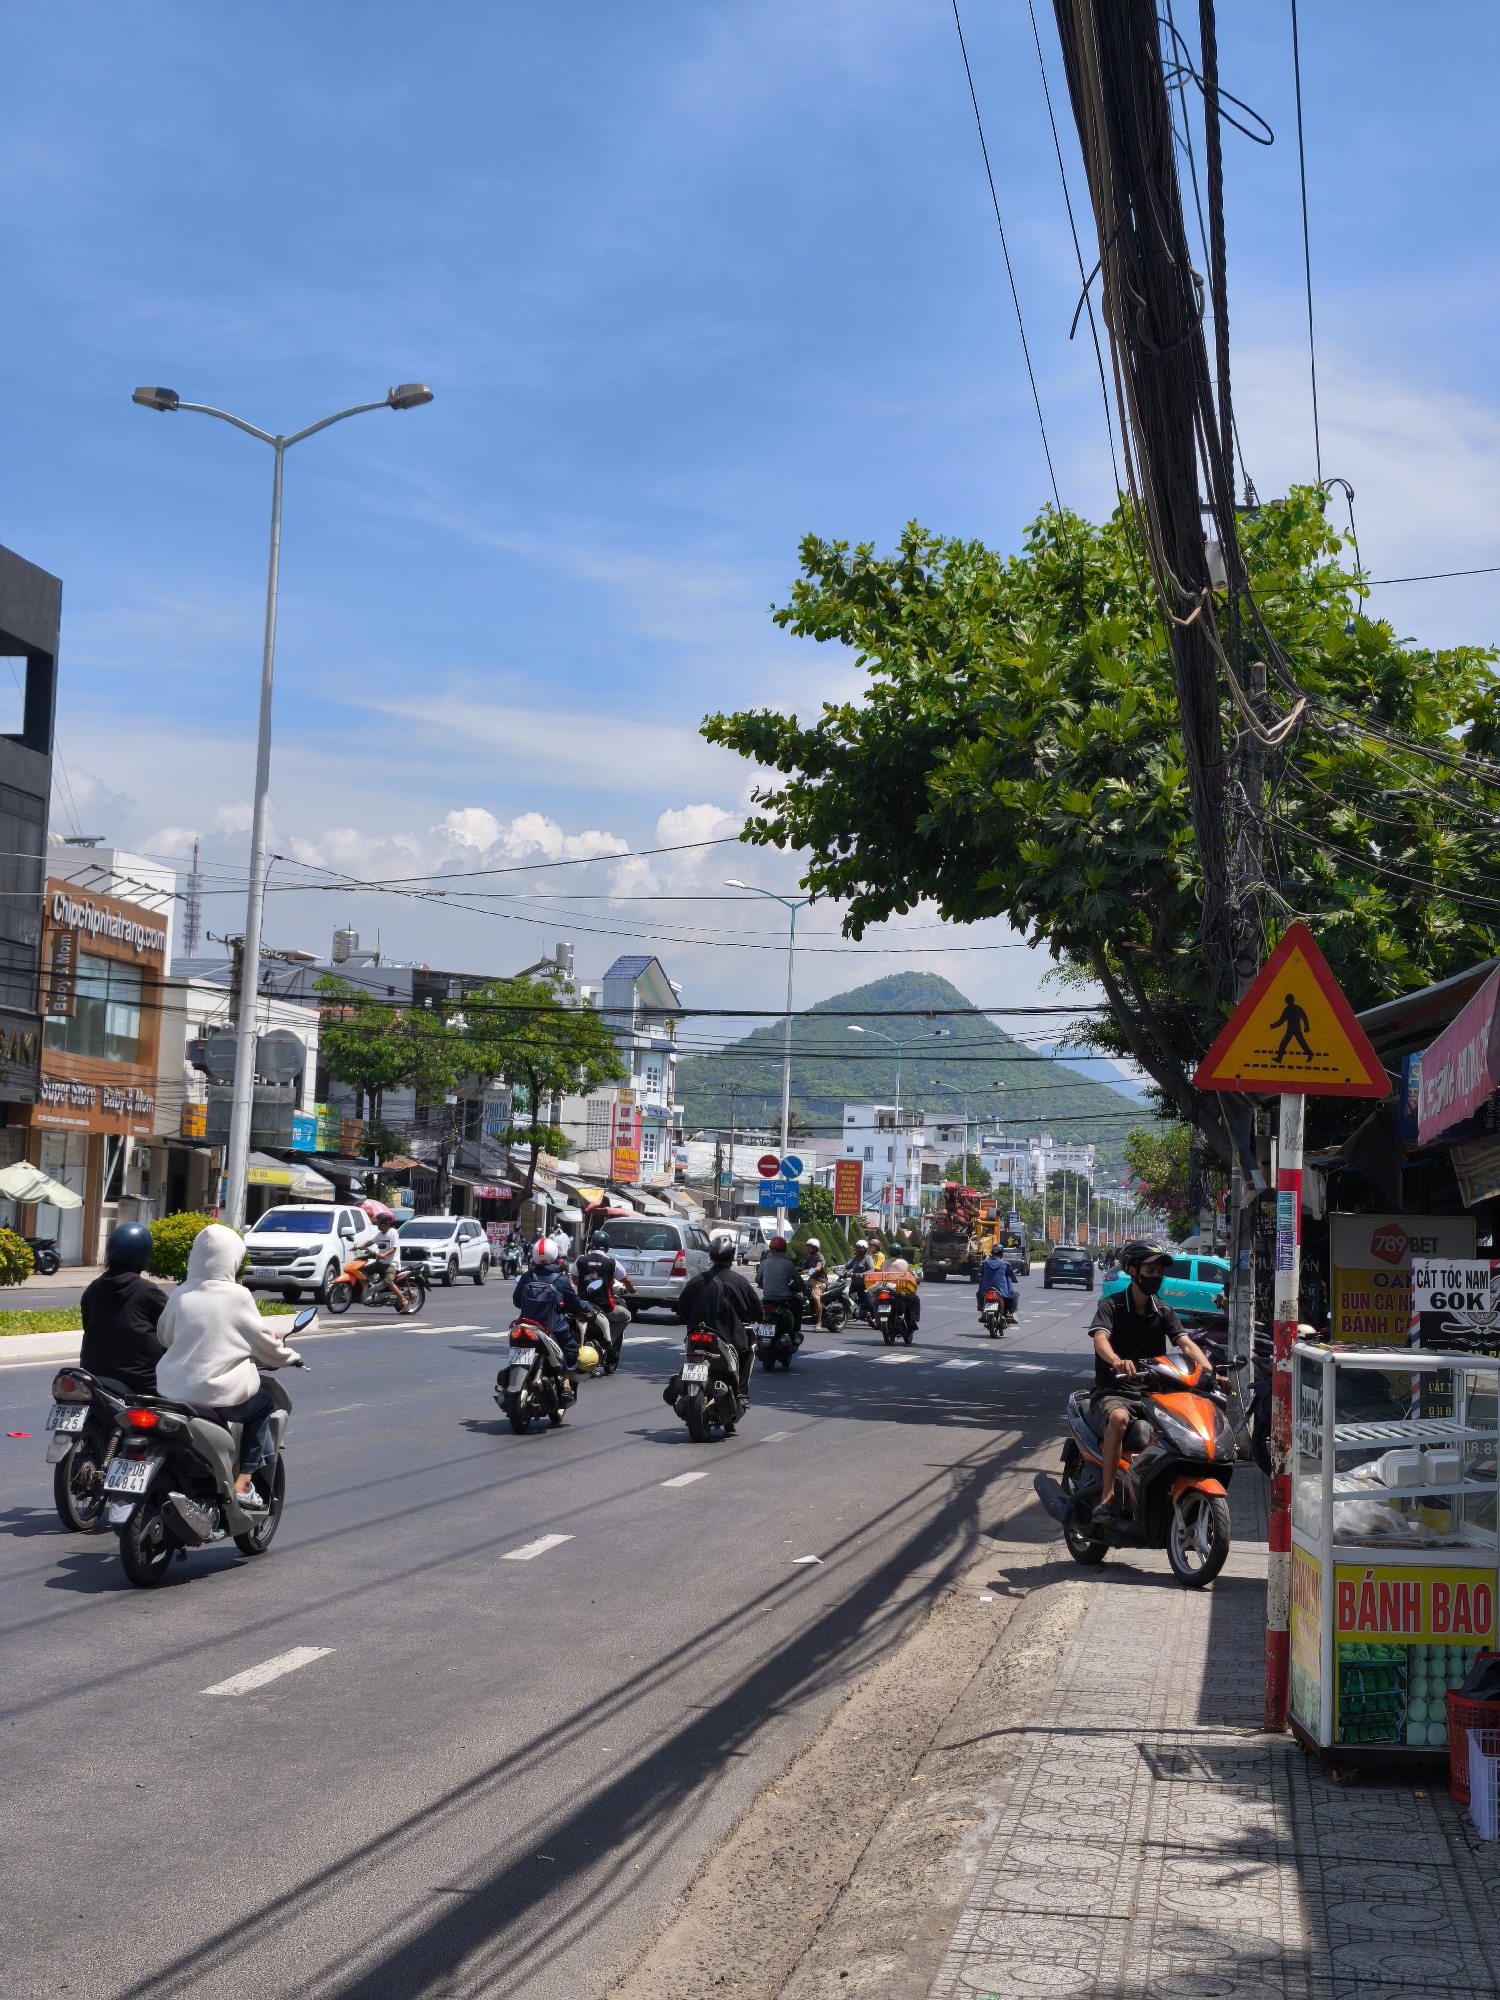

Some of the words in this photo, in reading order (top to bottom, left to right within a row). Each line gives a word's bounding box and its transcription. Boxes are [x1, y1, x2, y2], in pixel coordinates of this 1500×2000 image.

[53, 889, 166, 953] Chipchipnhatrang.com
[484, 1102, 508, 1119] PHOTO
[412, 1178, 438, 1195] PHOT
[1416, 1260, 1439, 1289] CẮT
[1440, 1264, 1463, 1290] TÓC
[1465, 1270, 1489, 1290] NAM
[1340, 1288, 1371, 1311] BÚN
[1374, 1289, 1395, 1311] CÁ
[1397, 1293, 1412, 1312] N
[1429, 1291, 1485, 1311] 60K
[1341, 1310, 1389, 1334] BÁNH
[1337, 1570, 1421, 1634] BÁNH
[1431, 1581, 1493, 1636] BAO
